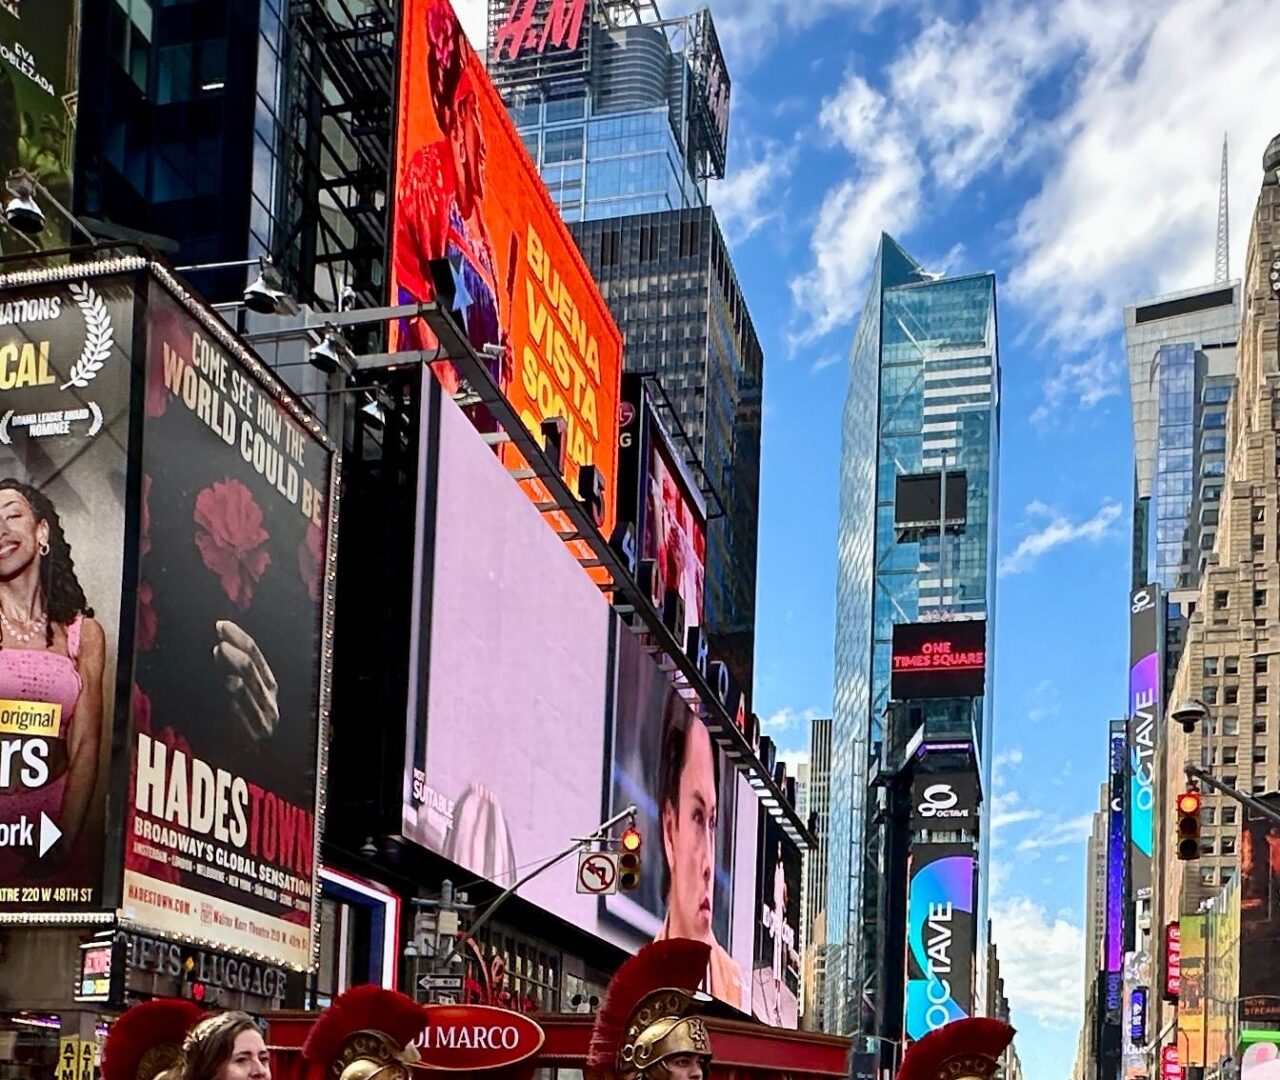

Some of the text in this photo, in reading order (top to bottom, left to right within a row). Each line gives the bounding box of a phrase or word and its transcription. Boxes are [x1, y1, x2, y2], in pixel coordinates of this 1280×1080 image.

[15, 42, 35, 67] EVA
[528, 222, 601, 386] BUENA
[526, 279, 599, 443] VISTA
[192, 331, 306, 468] COME SEE HOW THE
[29, 420, 70, 437] NOMINEE
[163, 341, 323, 529] WORLD COULD BE
[893, 652, 983, 668] TIMES SQUARE
[921, 642, 951, 654] ONE
[2, 706, 55, 730] original
[1135, 688, 1154, 812] OCTAVE
[135, 732, 313, 877] HADESTOWN
[936, 809, 969, 818] OCTAVE
[134, 817, 312, 899] BROADWAY'S GLOBAL SENSATION
[22, 888, 40, 902] 220
[41, 888, 52, 902] W
[78, 888, 93, 902] ST
[196, 950, 289, 1001] LUGGAGE
[925, 900, 953, 1030] OCTAVE
[435, 1026, 519, 1050] MARCO
